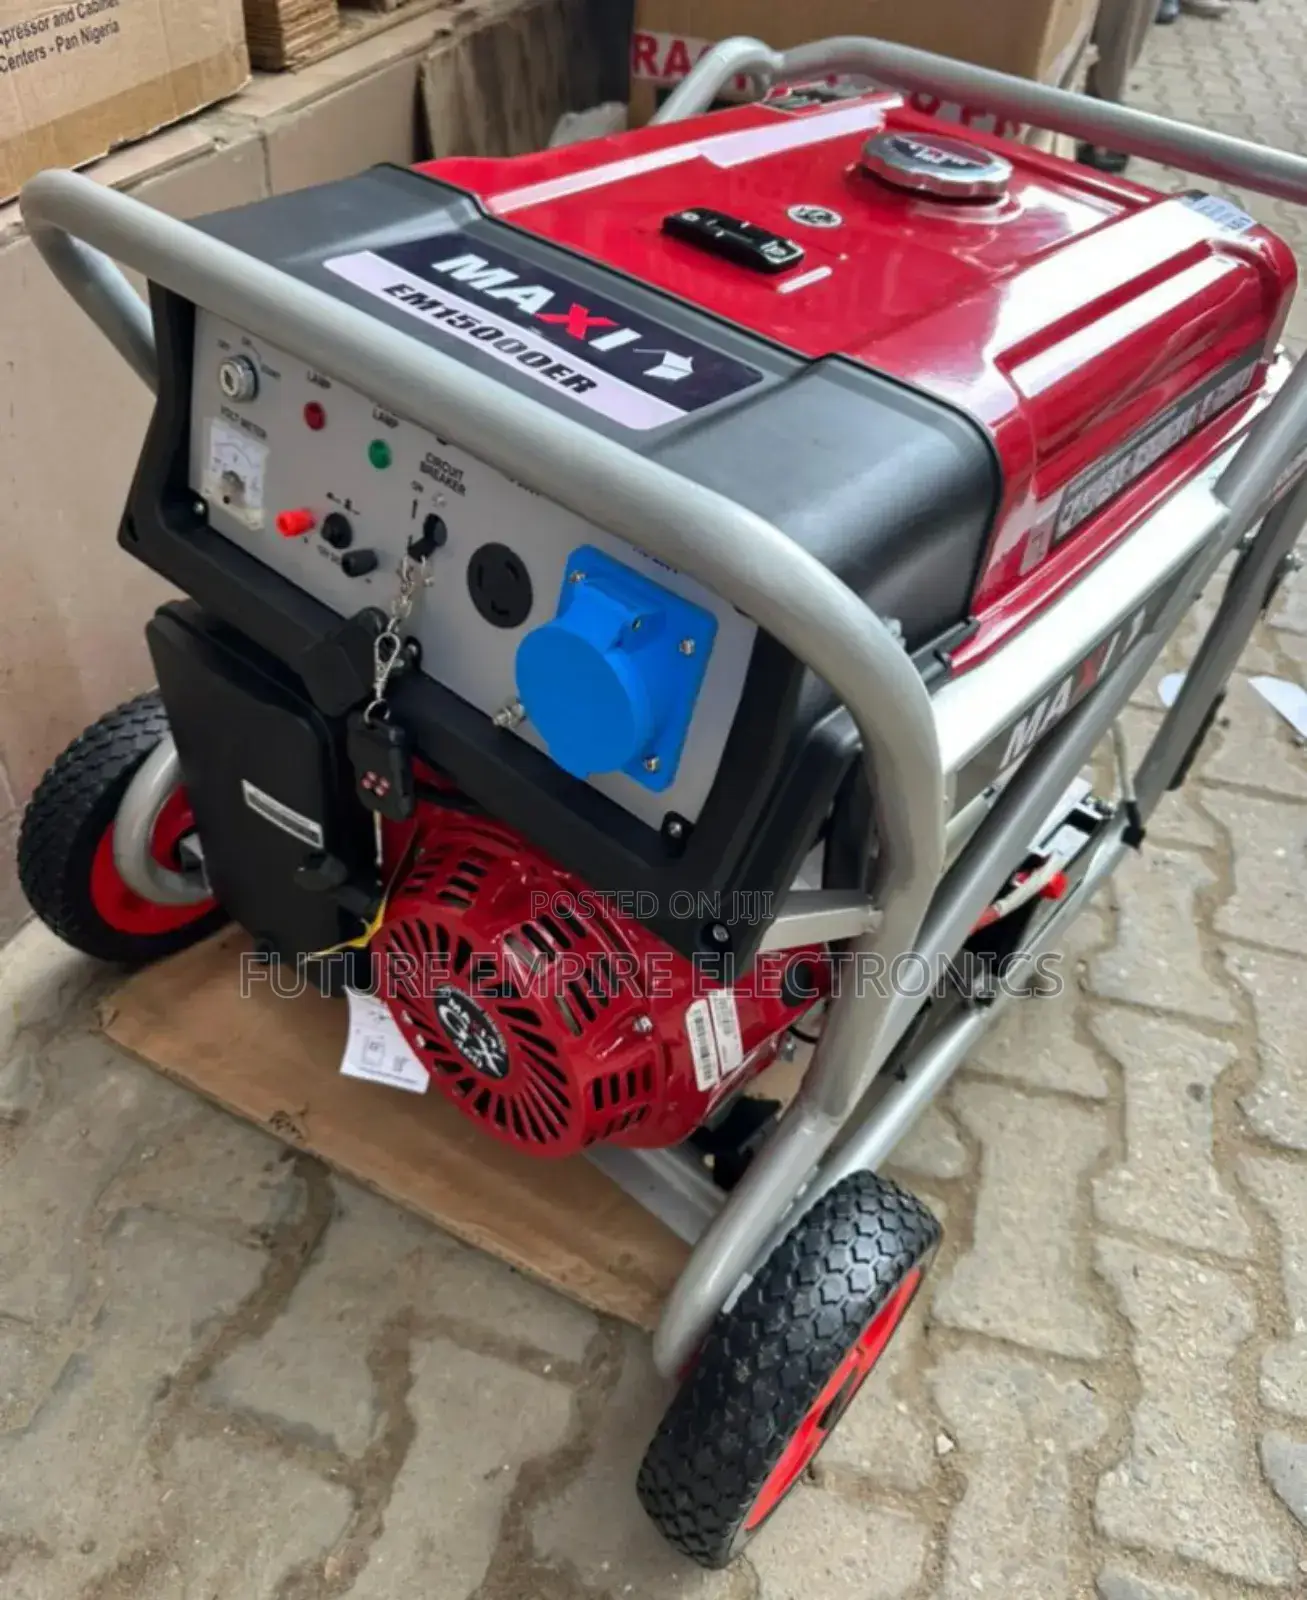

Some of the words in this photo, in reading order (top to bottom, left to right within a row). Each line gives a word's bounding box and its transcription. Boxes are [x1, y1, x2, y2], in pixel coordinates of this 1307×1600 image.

[0, 18, 48, 48] pressor
[53, 7, 75, 27] and
[0, 46, 46, 73] Centers
[56, 33, 79, 52] Pan
[80, 18, 119, 44] Nigeria
[383, 283, 599, 395] EM15000ER
[431, 253, 642, 352] MAXI
